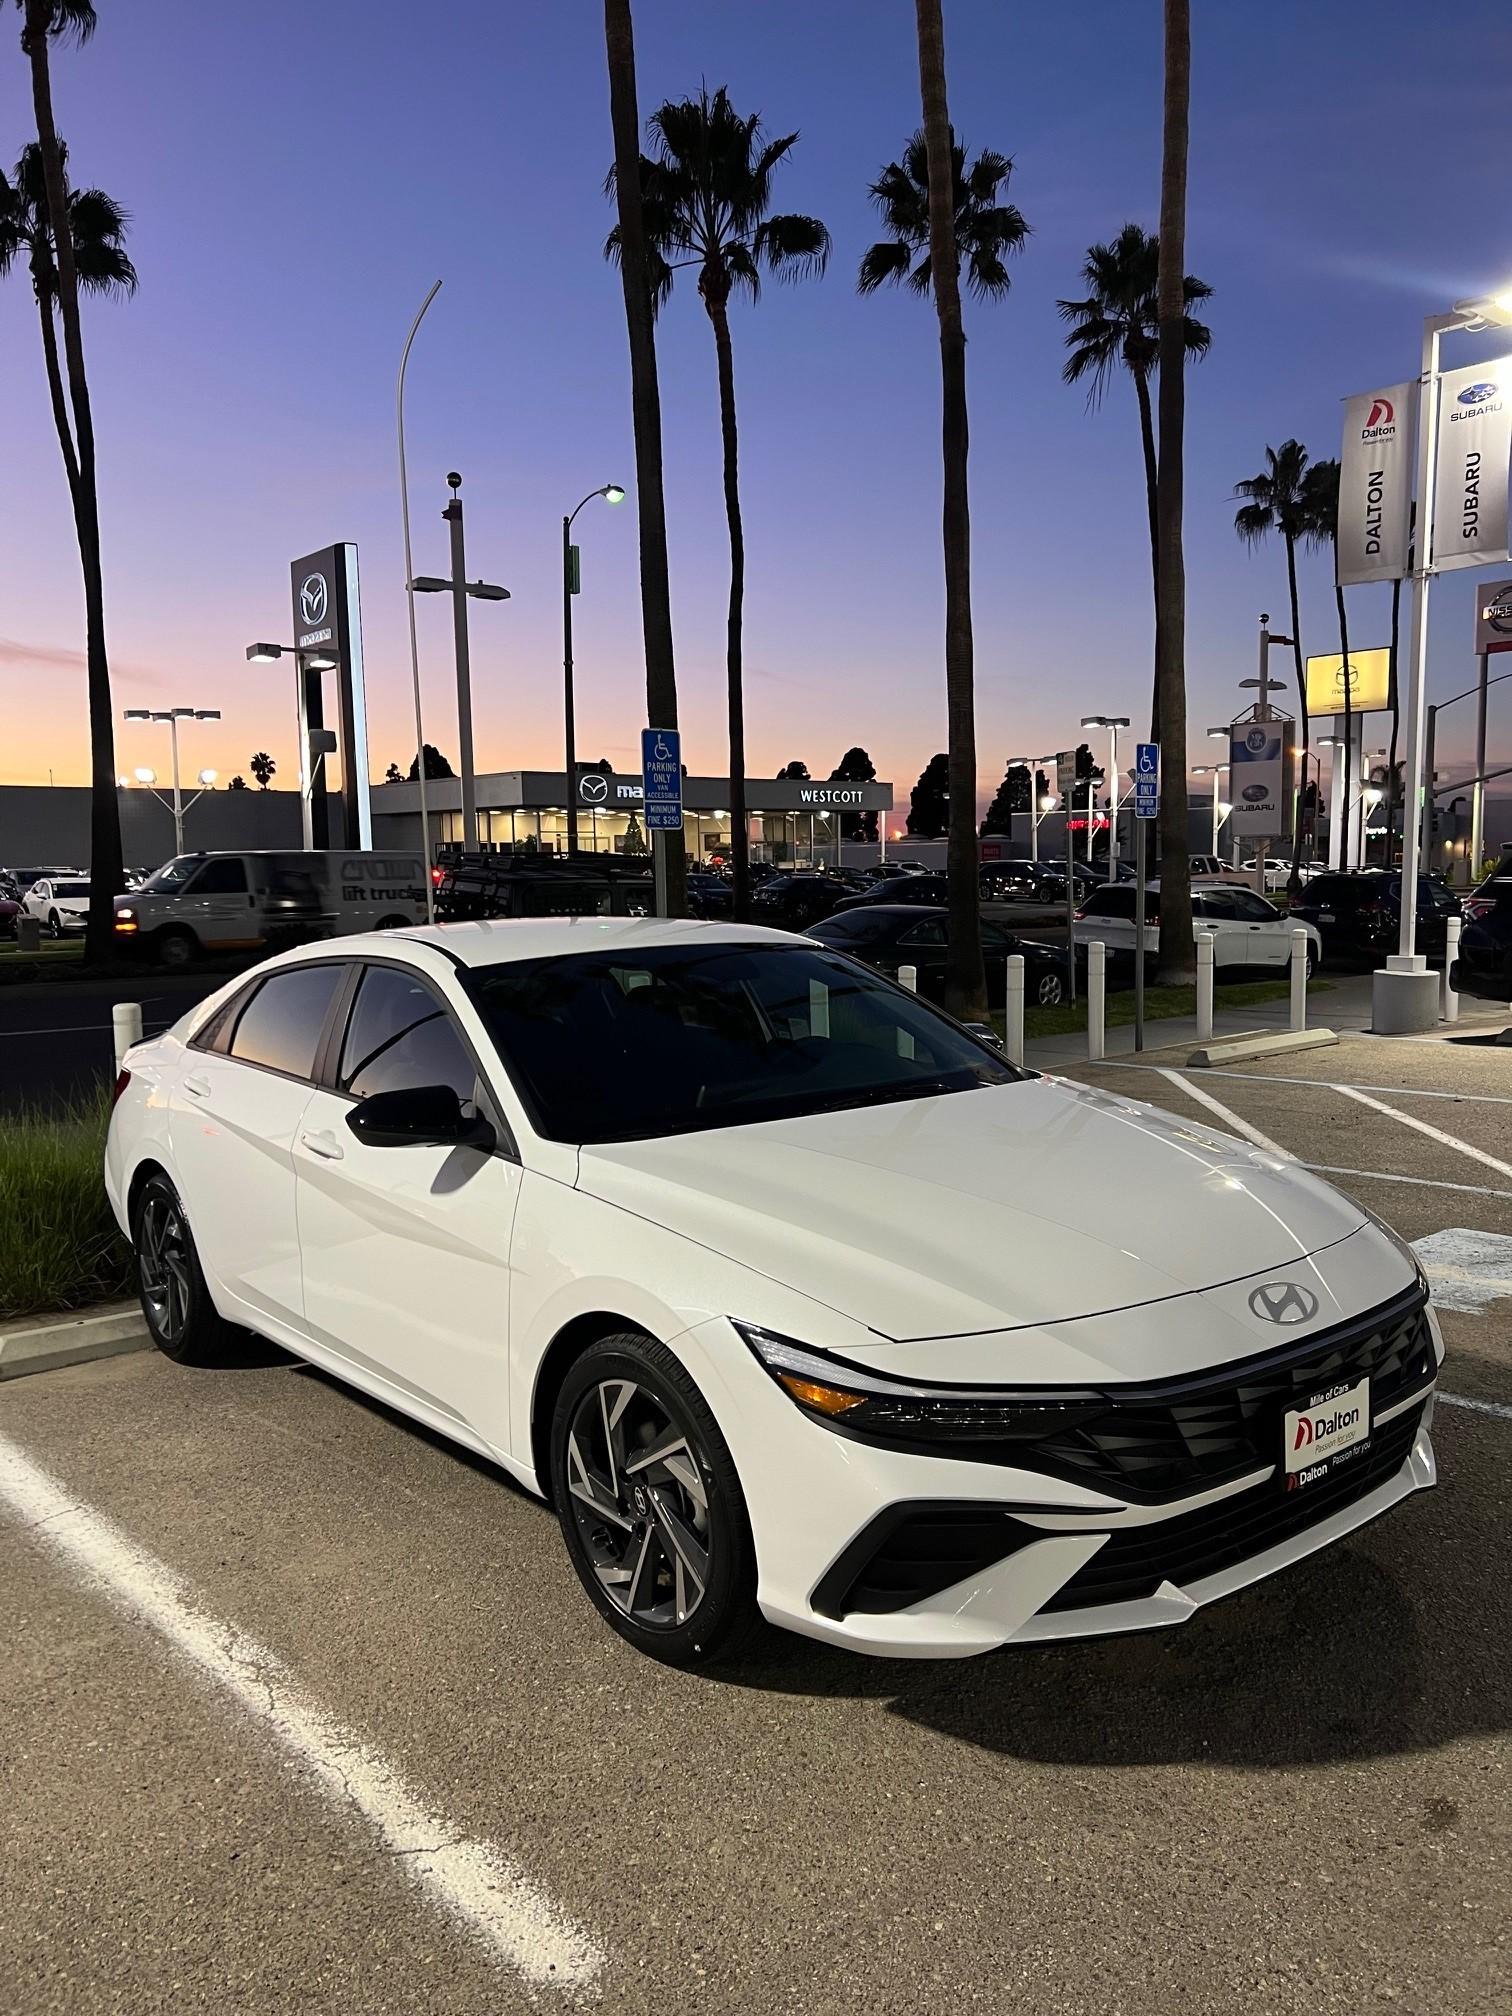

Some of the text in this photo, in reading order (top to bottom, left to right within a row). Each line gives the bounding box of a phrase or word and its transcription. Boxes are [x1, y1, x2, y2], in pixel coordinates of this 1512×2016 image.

[1450, 402, 1502, 421] SUBARU
[1361, 426, 1396, 439] Dalton
[1463, 452, 1481, 538] SUBARU
[1365, 470, 1384, 555] DALTON
[1489, 605, 1512, 617] NISS
[1332, 687, 1360, 695] mada
[647, 761, 677, 772] PARKING
[653, 773, 671, 784] ONLY
[800, 790, 863, 803] WESTCOTT
[650, 804, 677, 814] MINIMUM
[1235, 804, 1275, 812] SUBARU
[647, 815, 680, 825] FINE $250
[1309, 1383, 1349, 1407] Mile of Cars
[1315, 1408, 1359, 1441] Dalton
[1332, 1440, 1372, 1466] Passion for you
[1300, 1464, 1328, 1486] Dalton
